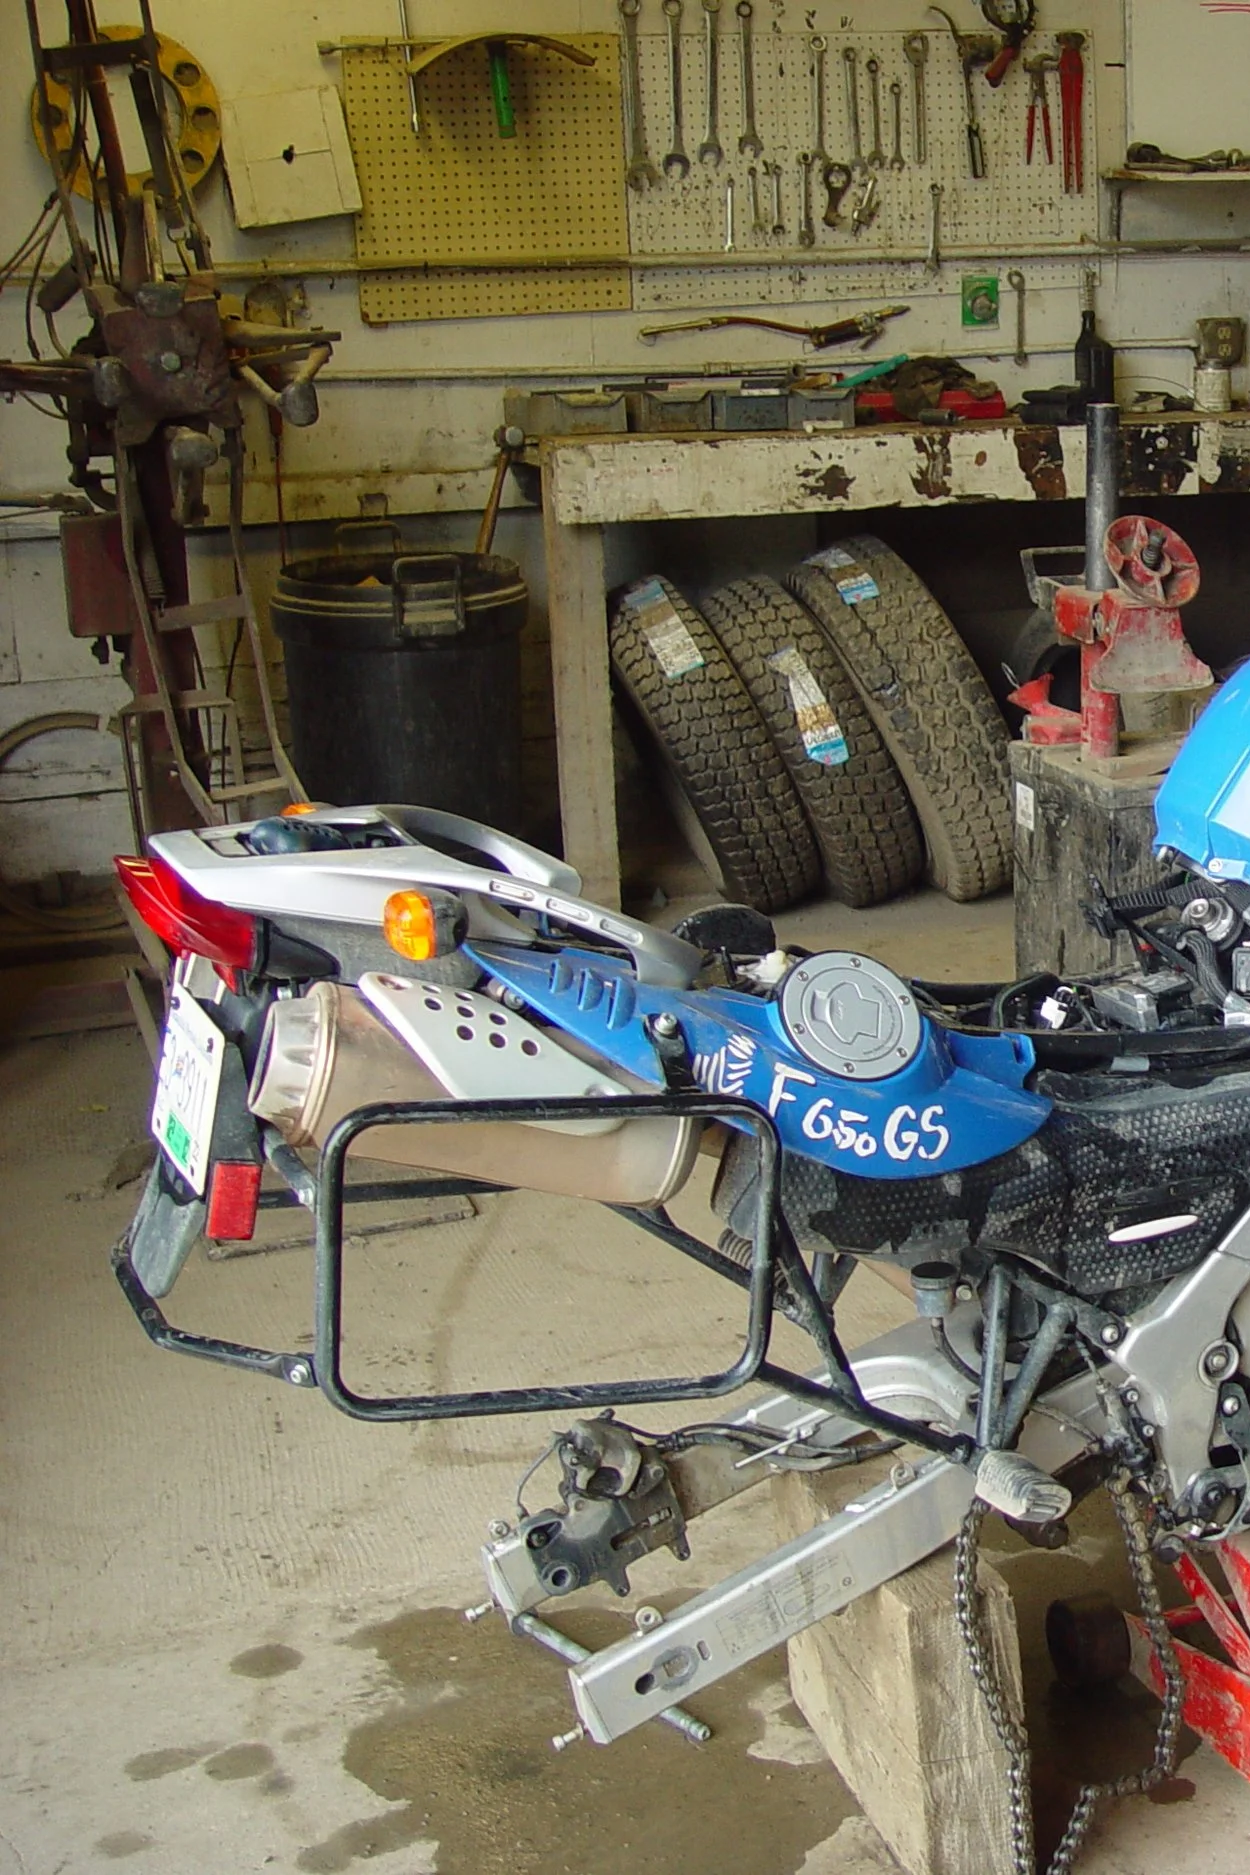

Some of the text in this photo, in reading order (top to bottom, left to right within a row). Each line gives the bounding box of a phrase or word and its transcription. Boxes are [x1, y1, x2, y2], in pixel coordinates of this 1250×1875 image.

[768, 1062, 950, 1161] F 650 GS
